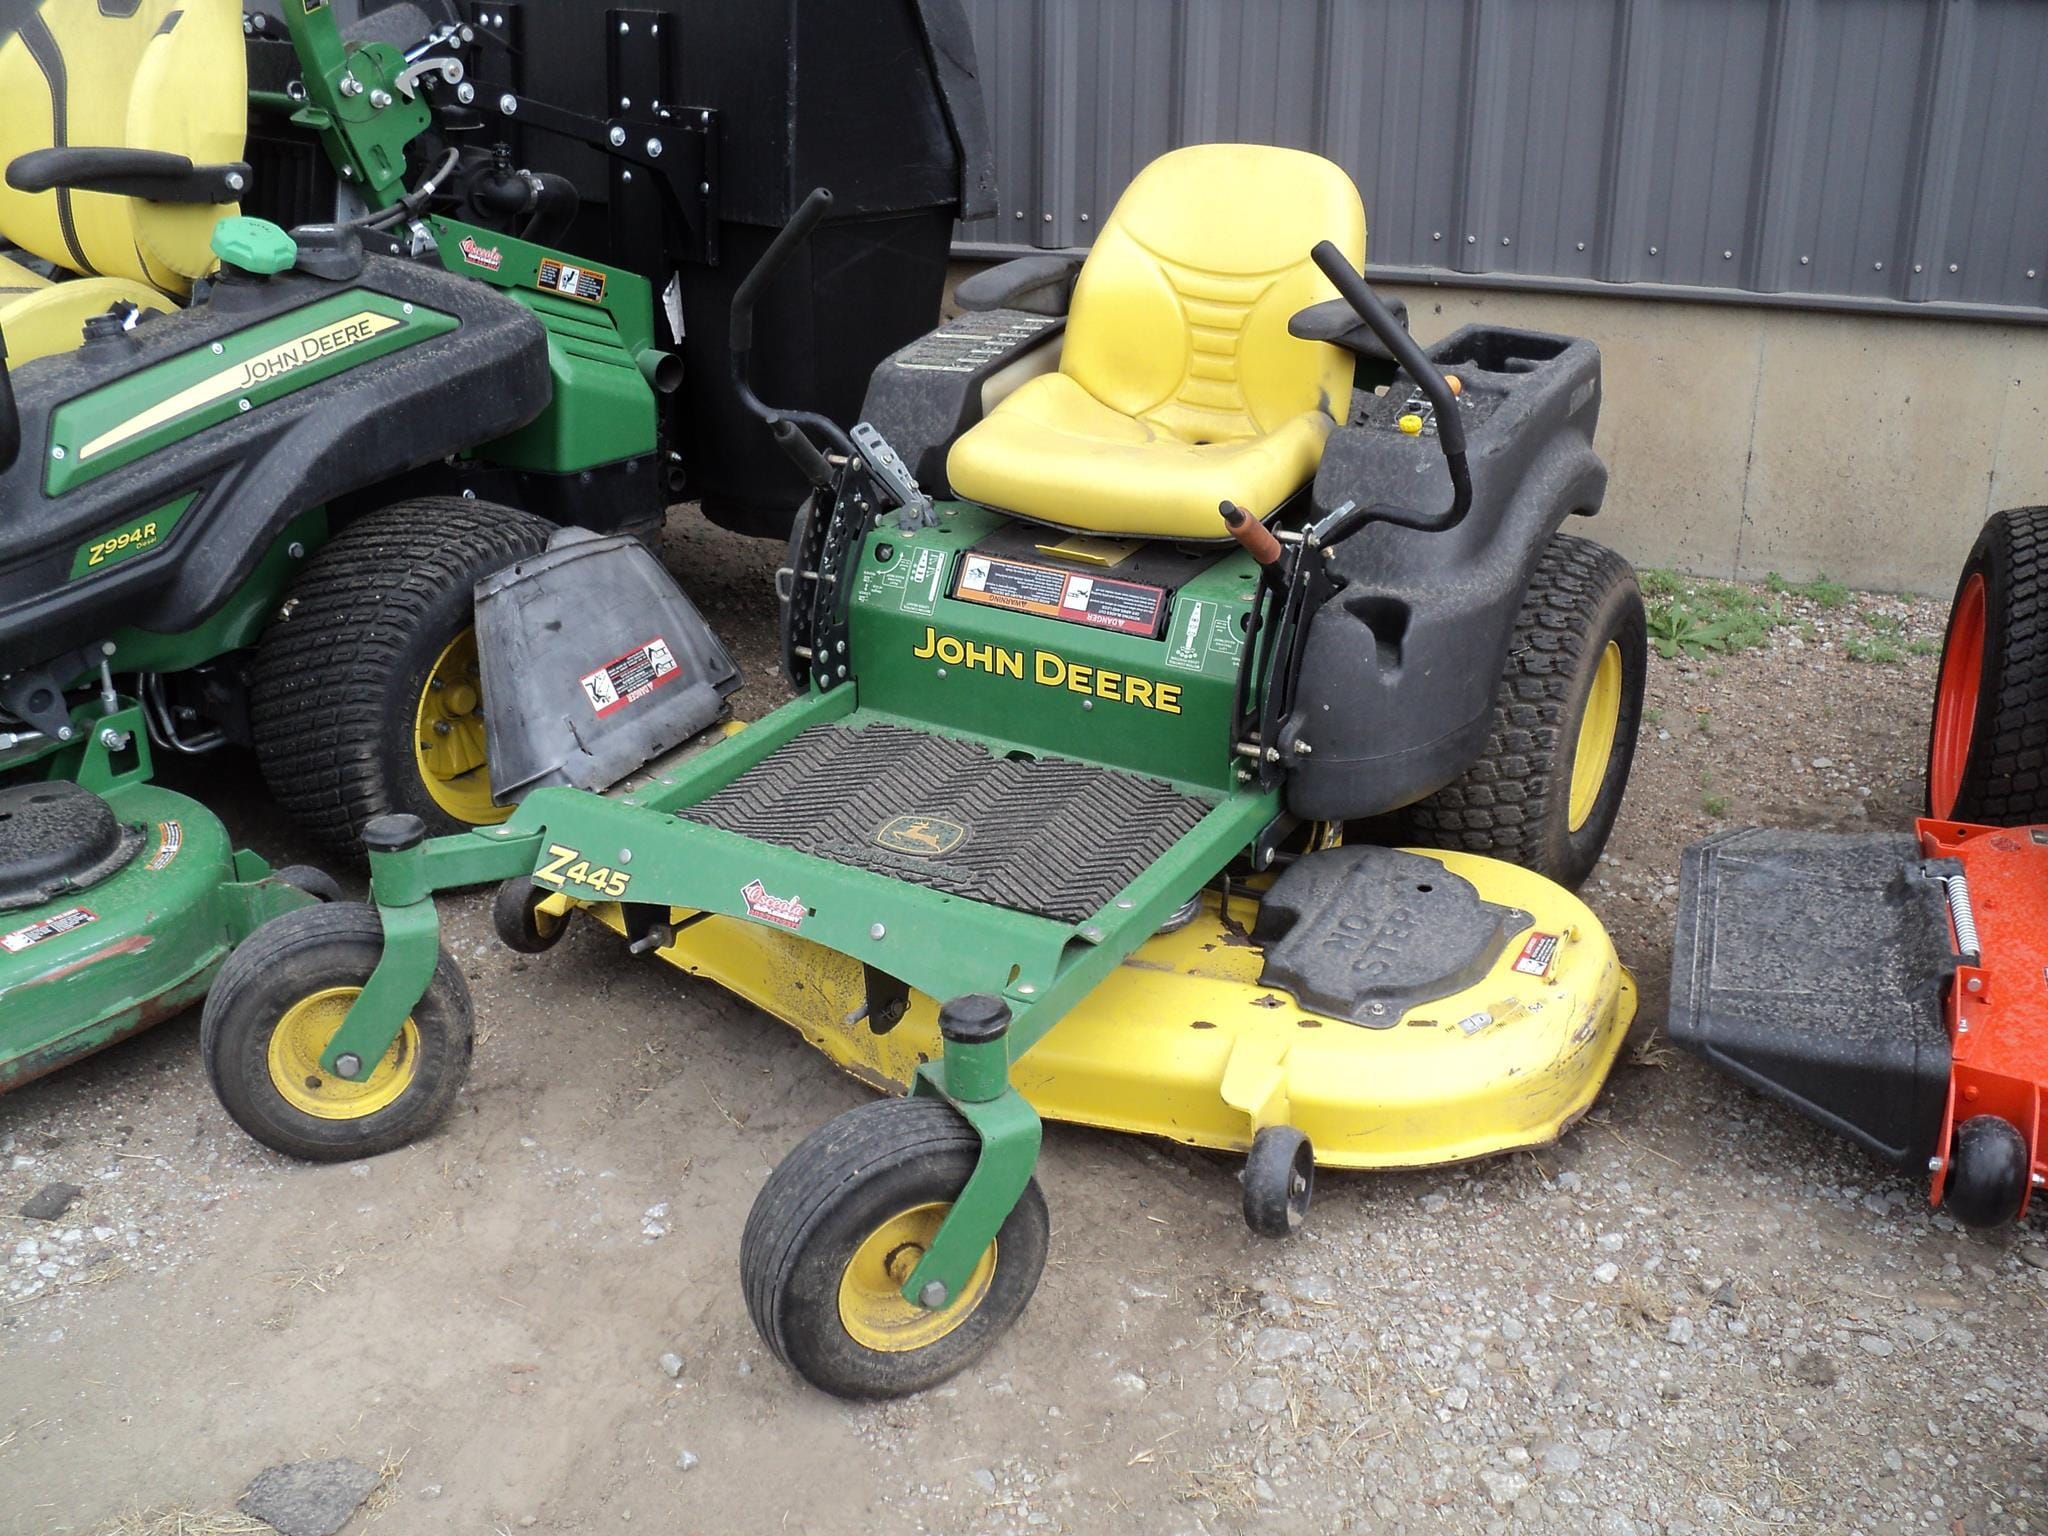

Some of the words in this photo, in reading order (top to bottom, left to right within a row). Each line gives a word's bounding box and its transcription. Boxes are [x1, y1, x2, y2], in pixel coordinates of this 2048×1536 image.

[241, 348, 299, 386] JOHN
[301, 319, 373, 359] DEERE
[88, 522, 157, 566] Z994R
[136, 536, 157, 550] Diesel
[989, 594, 1021, 606] WARNING
[1087, 613, 1120, 626] DANGER
[913, 626, 1024, 680] JOHN
[1034, 648, 1182, 714] DEERE
[626, 684, 650, 703] DANGER
[535, 843, 631, 897] Z445
[745, 885, 803, 915] Osceola
